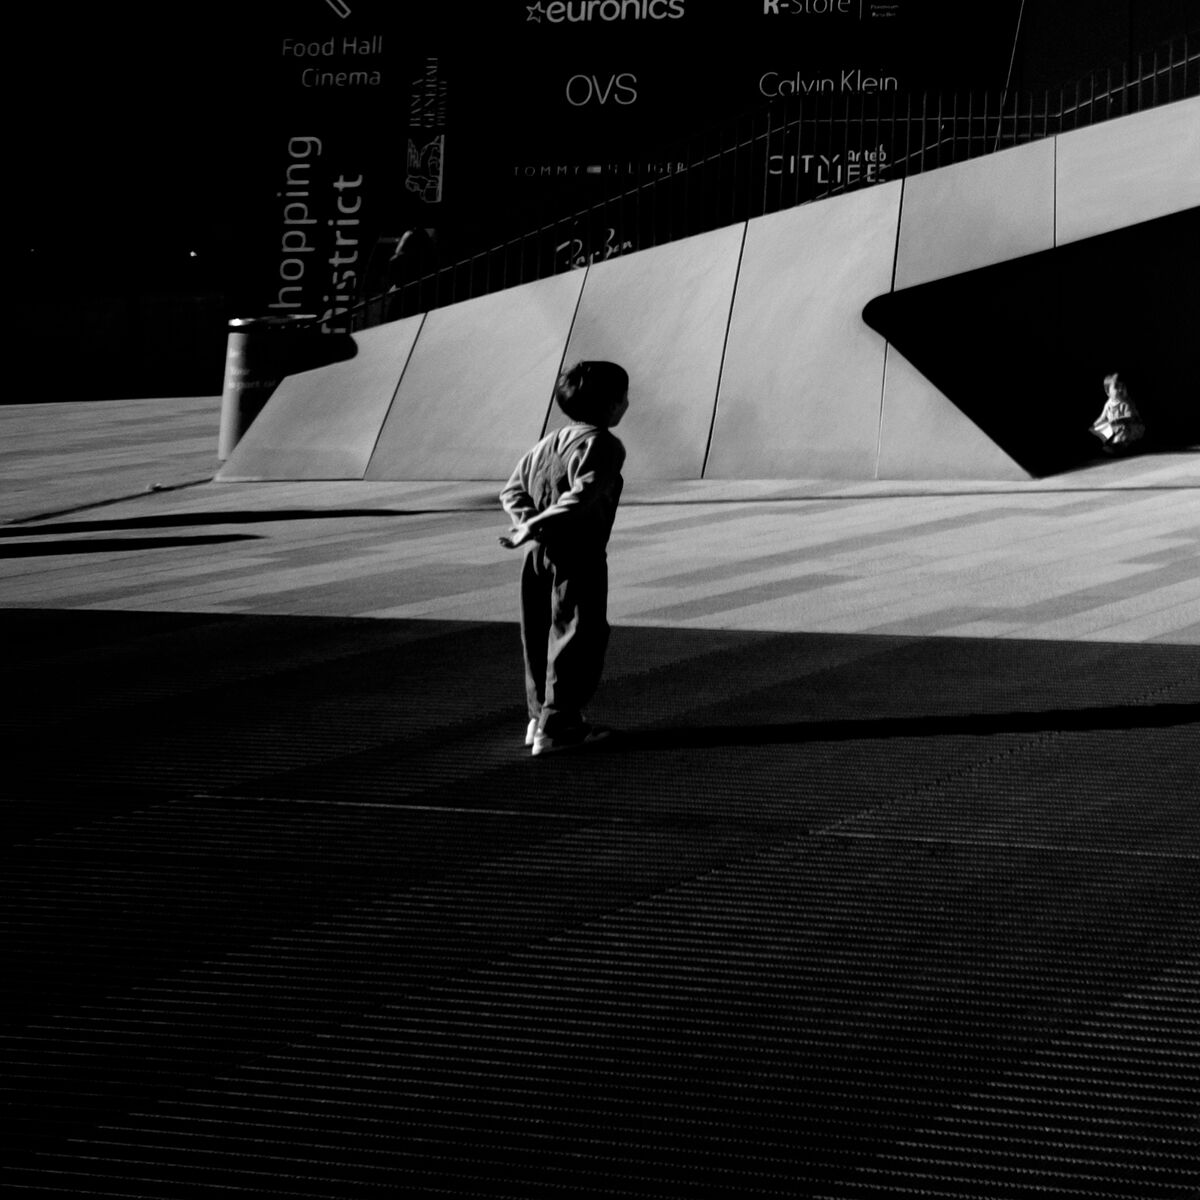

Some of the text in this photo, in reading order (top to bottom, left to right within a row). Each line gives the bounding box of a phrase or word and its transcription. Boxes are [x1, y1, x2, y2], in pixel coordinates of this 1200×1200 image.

[282, 35, 383, 57] Food Hall
[301, 67, 382, 88] Cinema
[566, 73, 638, 107] OVS
[759, 68, 898, 97] Calvin Klein
[513, 164, 580, 177] TOMMY
[268, 135, 324, 310] hopping
[320, 174, 364, 336] District
